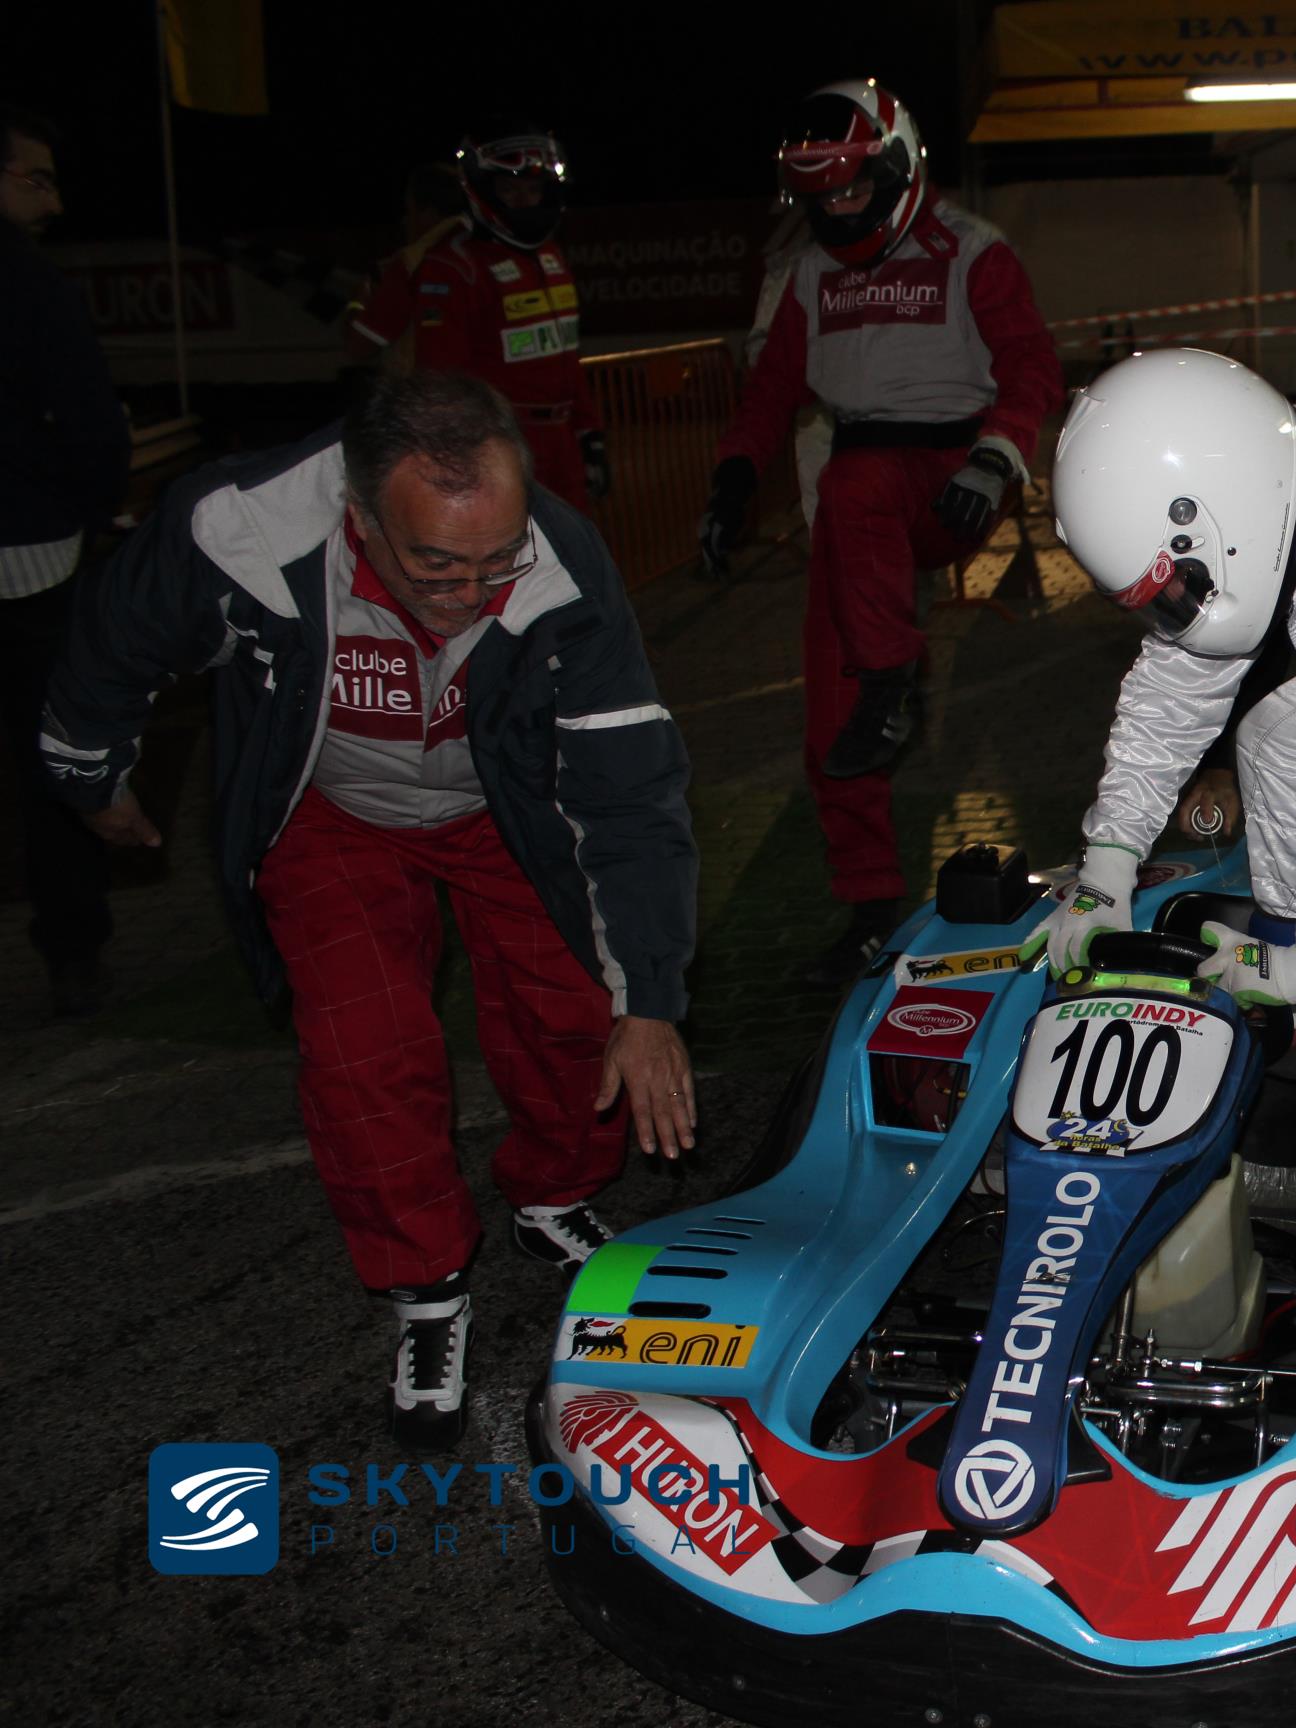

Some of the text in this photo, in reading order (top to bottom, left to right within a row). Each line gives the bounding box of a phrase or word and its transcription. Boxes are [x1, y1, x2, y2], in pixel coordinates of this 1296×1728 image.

[84, 270, 223, 327] URON
[821, 280, 940, 313] Millennium
[896, 303, 921, 318] bcp
[334, 648, 408, 677] clube
[963, 952, 1020, 974] en
[900, 1010, 961, 1025] Millennium
[1055, 1001, 1206, 1027] EUROINDY
[1048, 1019, 1182, 1127] 100
[1059, 1117, 1113, 1140] 24
[981, 1171, 1101, 1433] TECNIROLO
[639, 1325, 746, 1367] eni
[613, 1426, 760, 1558] HURON
